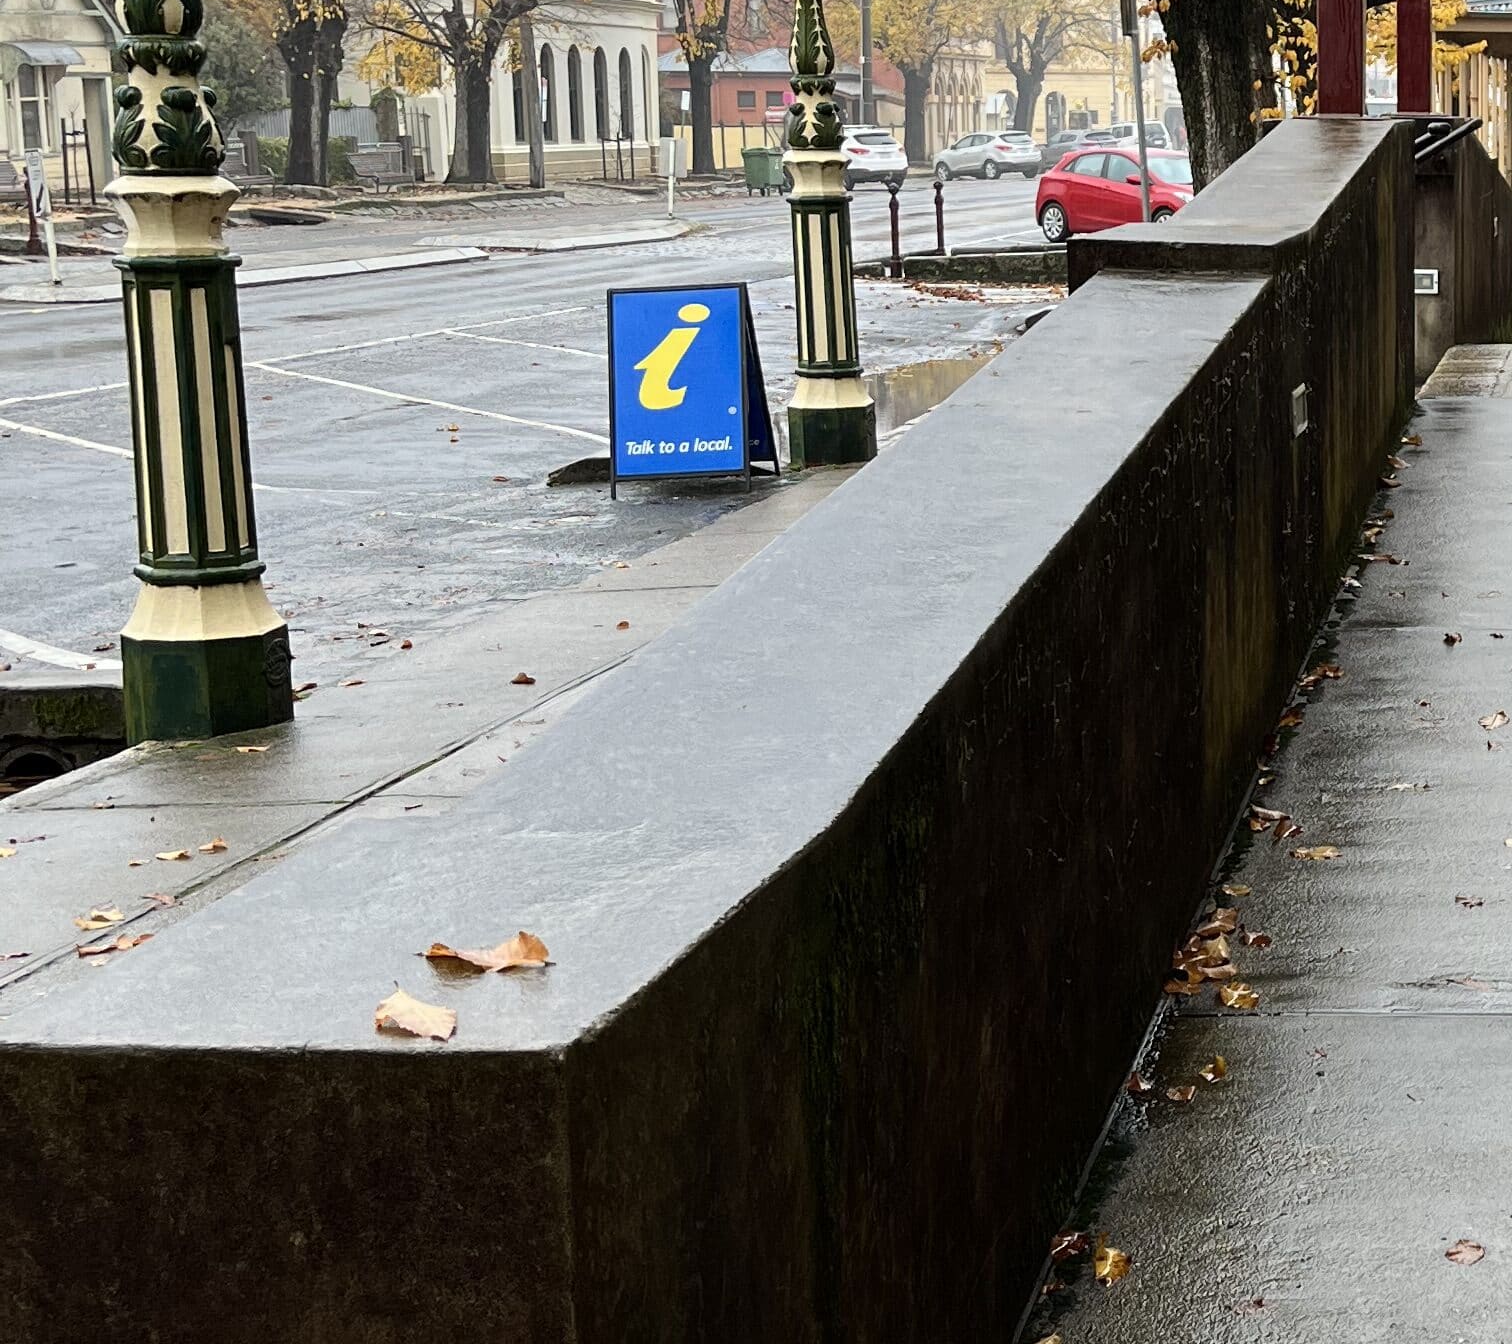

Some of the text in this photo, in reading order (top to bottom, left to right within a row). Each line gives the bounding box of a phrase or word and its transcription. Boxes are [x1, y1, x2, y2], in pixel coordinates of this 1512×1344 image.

[626, 440, 655, 455] Talk
[659, 440, 675, 454] to
[679, 441, 689, 453] a
[693, 436, 733, 452] local.
